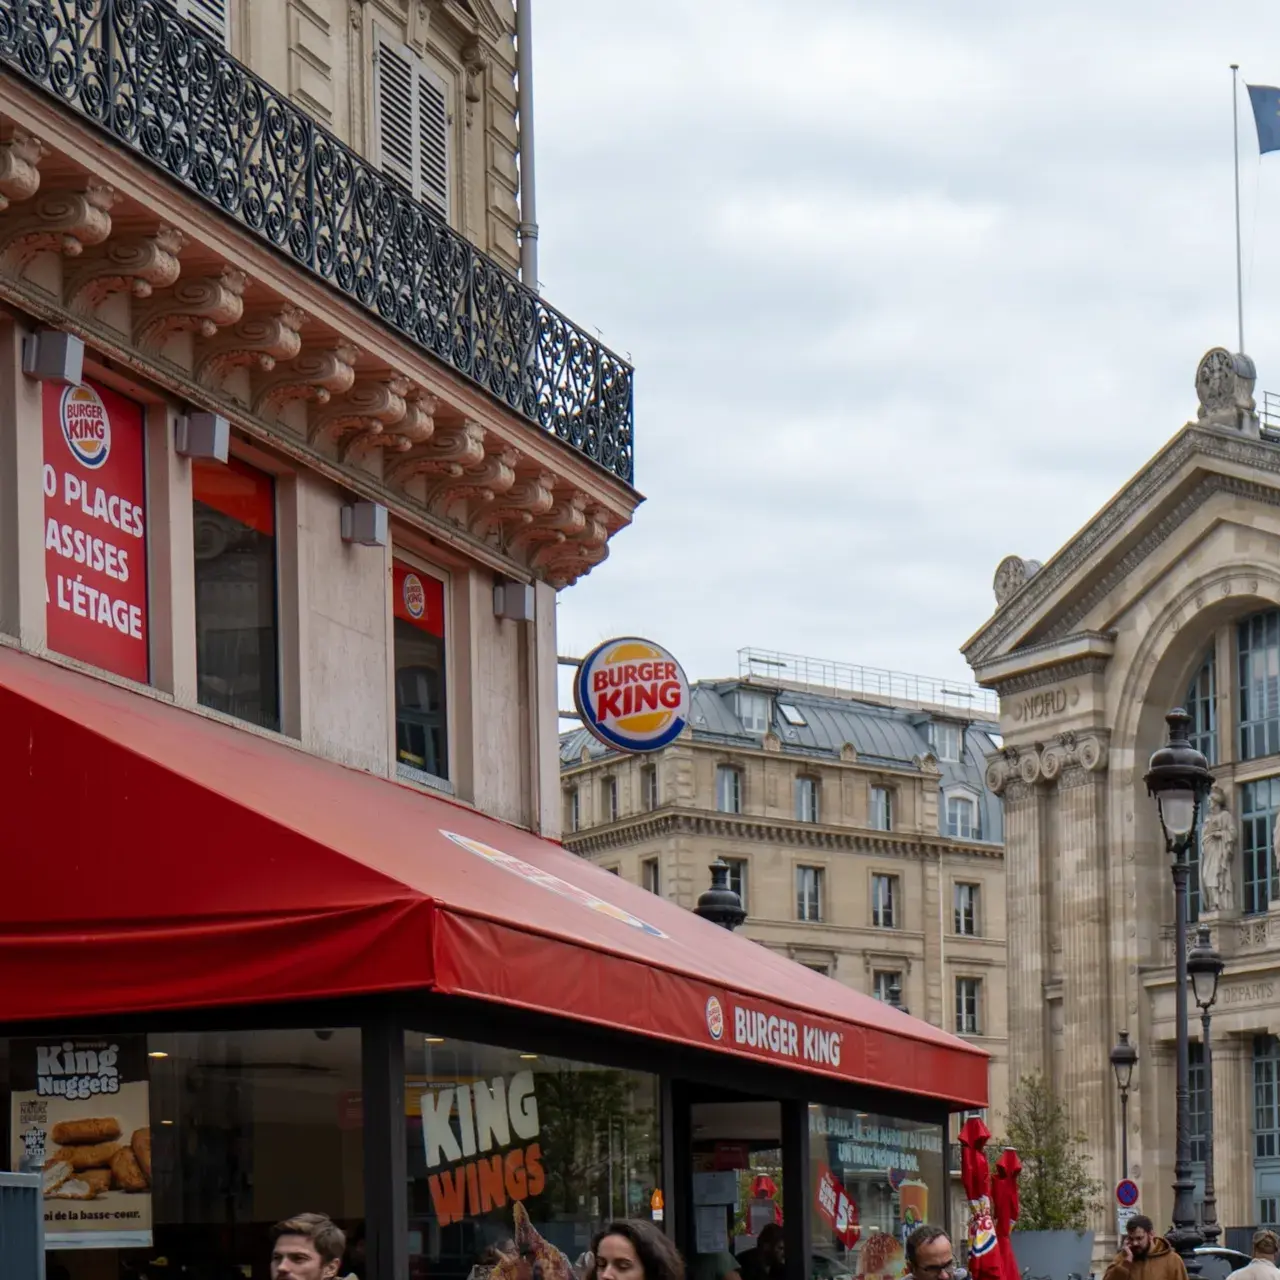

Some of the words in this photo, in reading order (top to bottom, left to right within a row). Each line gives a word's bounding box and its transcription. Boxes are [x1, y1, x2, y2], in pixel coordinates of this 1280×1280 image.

[67, 403, 104, 420] BURGER
[68, 419, 105, 441] KING
[63, 472, 144, 539] PLACES
[45, 517, 129, 583] ASSISES
[593, 661, 678, 693] BURGER
[597, 680, 681, 722] KING
[1022, 688, 1068, 722] NORD
[734, 1006, 799, 1057] BURGER
[803, 1025, 841, 1067] KING
[36, 1042, 119, 1077] King
[38, 1075, 119, 1099] Nuggets
[420, 1069, 540, 1169] KING
[428, 1143, 546, 1227] WINGS
[54, 1210, 67, 1221] de
[68, 1210, 79, 1221] la
